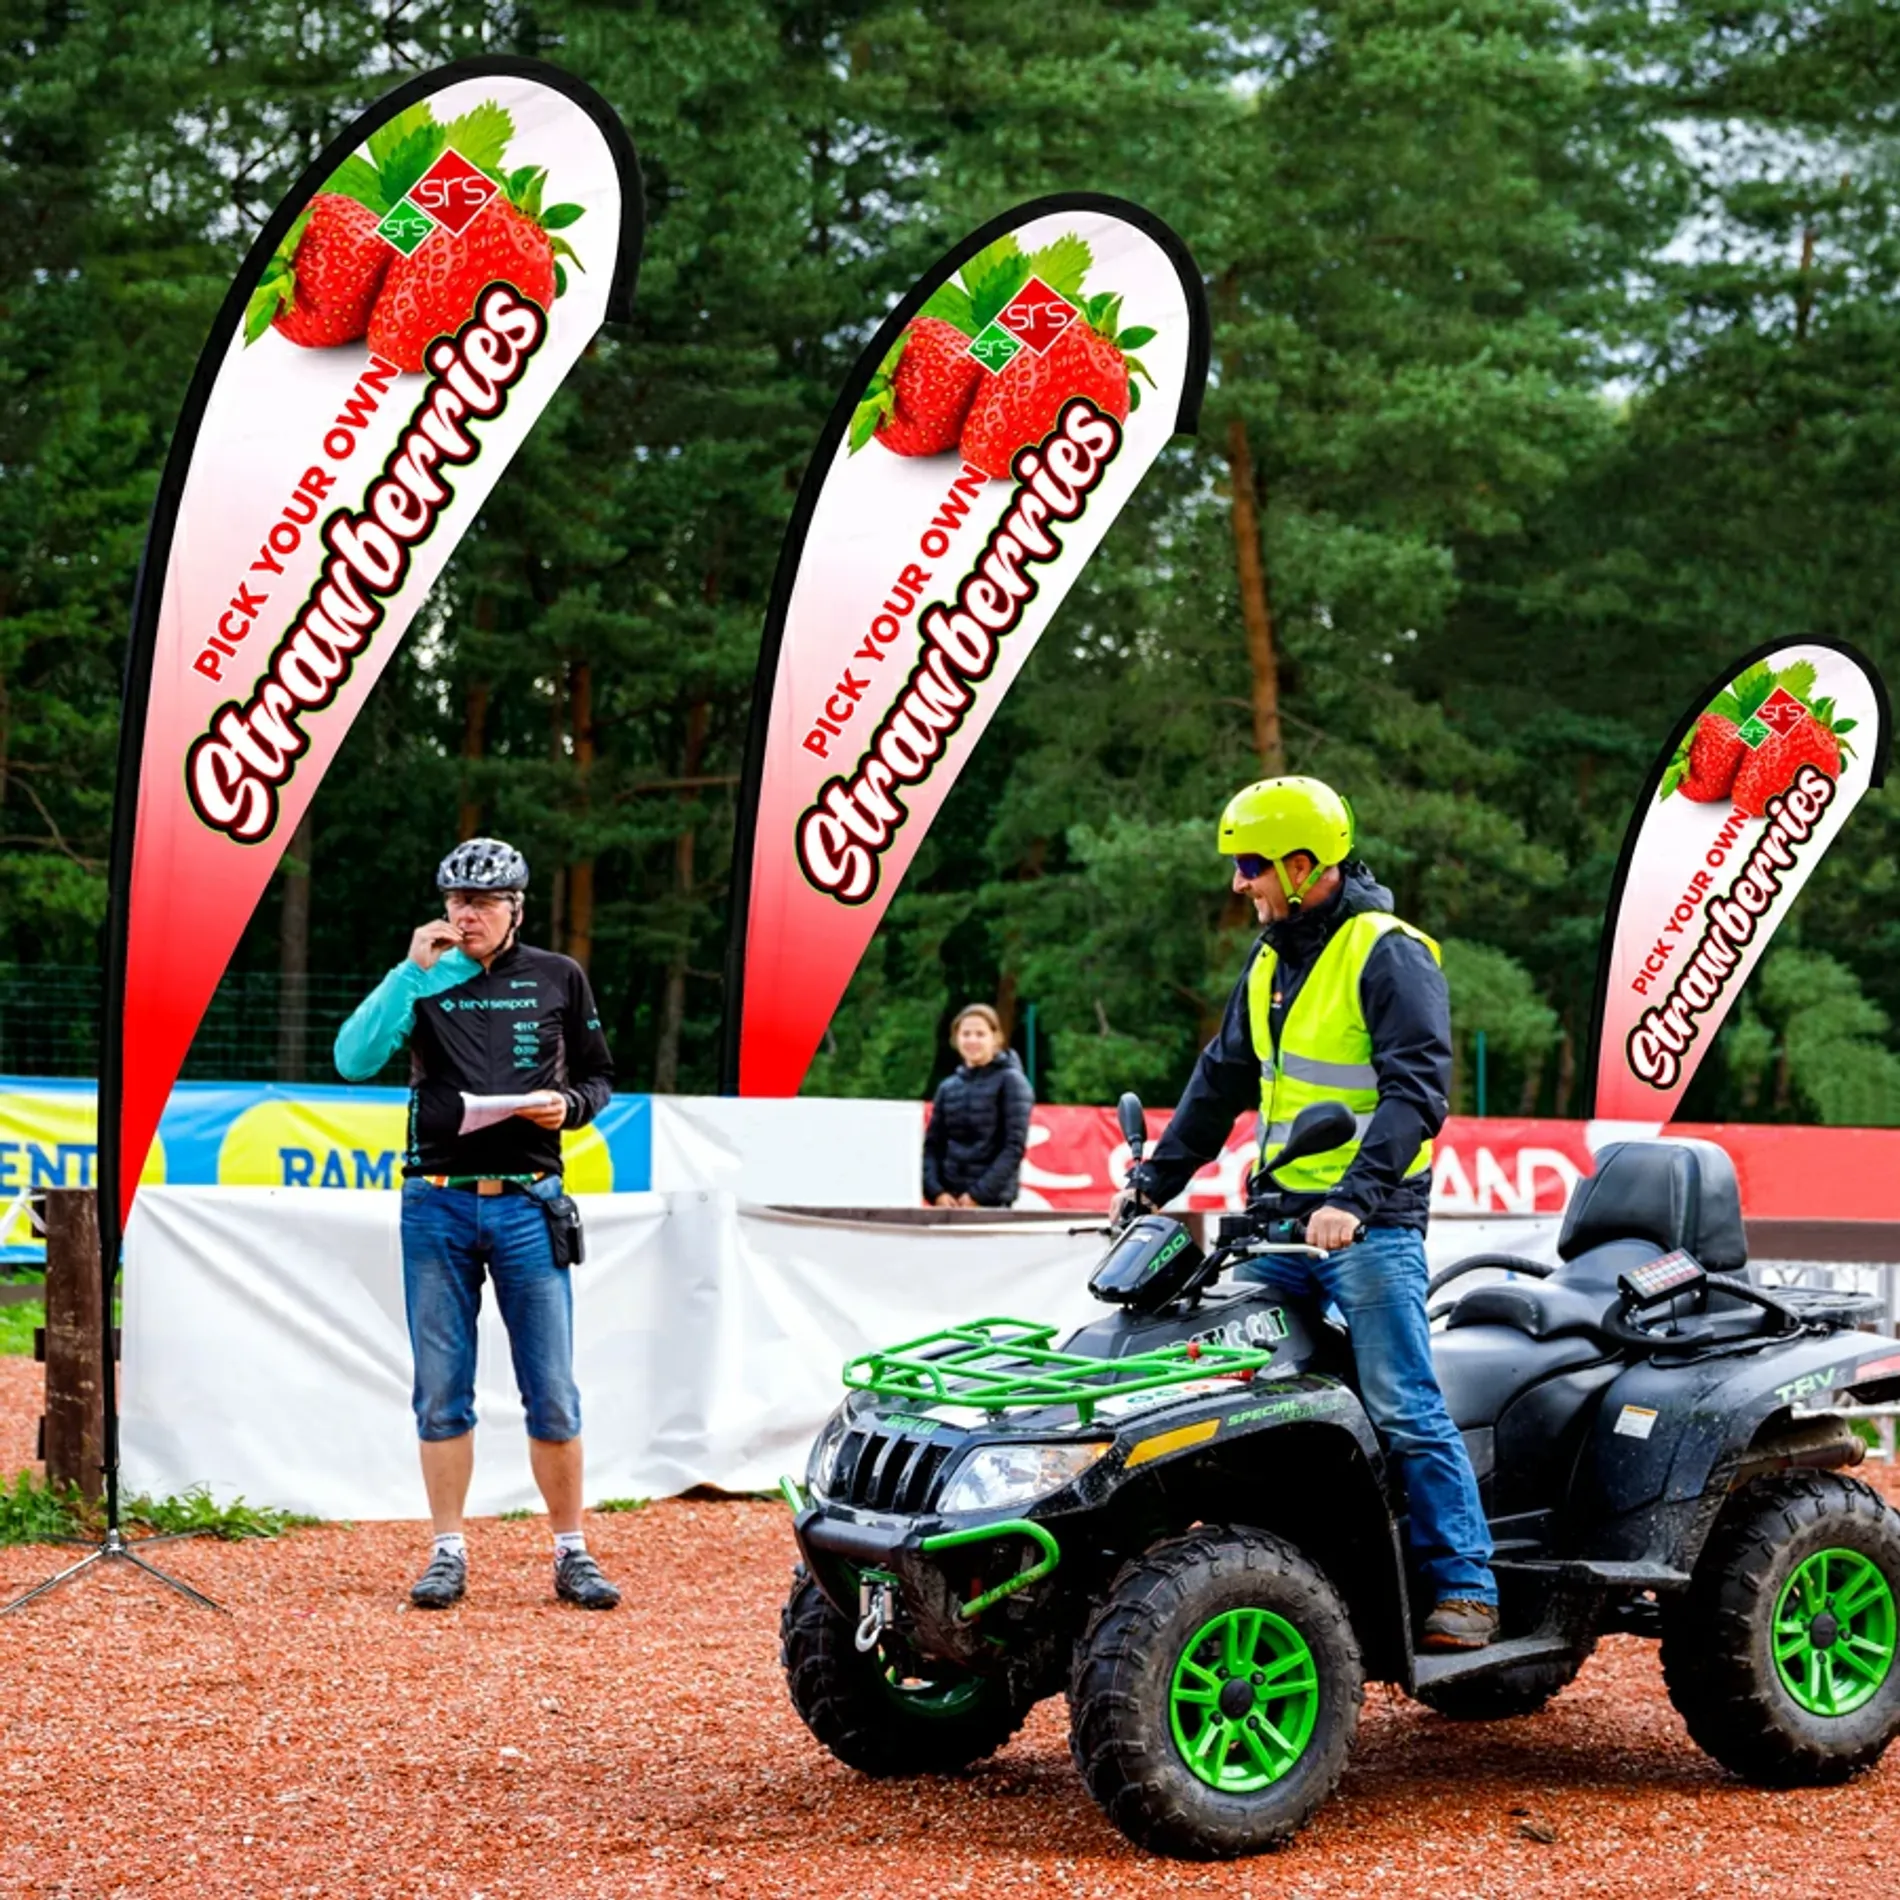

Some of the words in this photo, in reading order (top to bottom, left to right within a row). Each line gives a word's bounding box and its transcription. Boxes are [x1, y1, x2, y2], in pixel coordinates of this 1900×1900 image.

[420, 175, 487, 208] srs
[384, 217, 428, 239] srs
[1007, 301, 1068, 331] srs
[975, 338, 1015, 358] srs
[192, 581, 269, 682] PICK
[249, 466, 337, 575] YOUR
[323, 355, 400, 460] OWN
[187, 285, 546, 841] Strawberries
[802, 668, 871, 759] PICK
[853, 563, 933, 662] YOUR
[920, 463, 990, 558] OWN
[798, 399, 1120, 903] Strawberries
[1631, 938, 1675, 996] PICK
[1664, 869, 1714, 933] YOUR
[1706, 807, 1750, 867] OWN
[1627, 765, 1835, 1087] Strawberries
[1148, 1233, 1186, 1272] 700
[1774, 1367, 1836, 1402] TRV
[1227, 1400, 1299, 1426] SPECIAL
